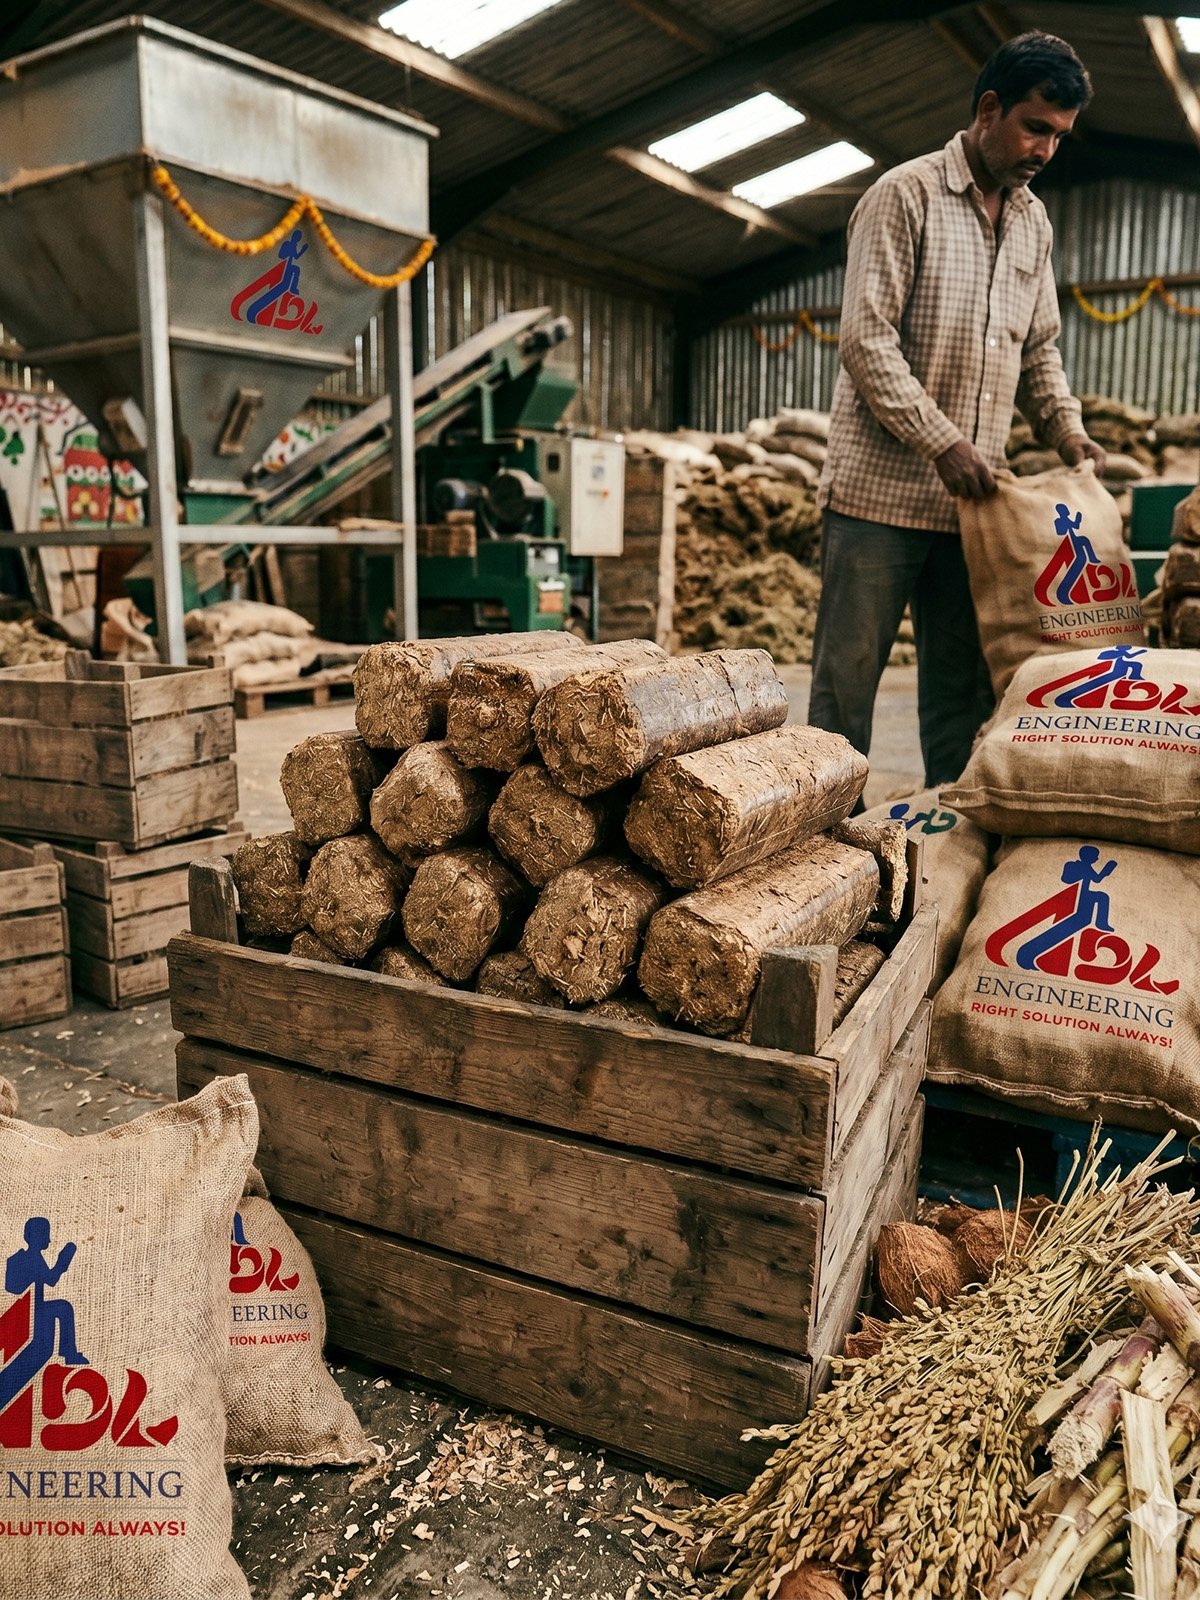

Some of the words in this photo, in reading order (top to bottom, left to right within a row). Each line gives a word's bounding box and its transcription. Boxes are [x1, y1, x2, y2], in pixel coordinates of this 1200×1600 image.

[1039, 604, 1145, 630] ENGINEERIN
[1041, 632, 1072, 643] RIGHT
[1075, 626, 1122, 639] SOLUTION
[1015, 715, 1200, 740] ENGINEERING
[1012, 734, 1057, 743] RIGHT
[1061, 734, 1134, 747] SOLUTION
[974, 975, 1174, 1028] ENGINEERING
[971, 1002, 1017, 1018] RIGHT
[1022, 1010, 1100, 1032] SOLUTION
[1105, 1025, 1173, 1049] ALWAYS!
[260, 1332, 311, 1345] ALWAYS!
[92, 1520, 186, 1537] ALWAYS!
